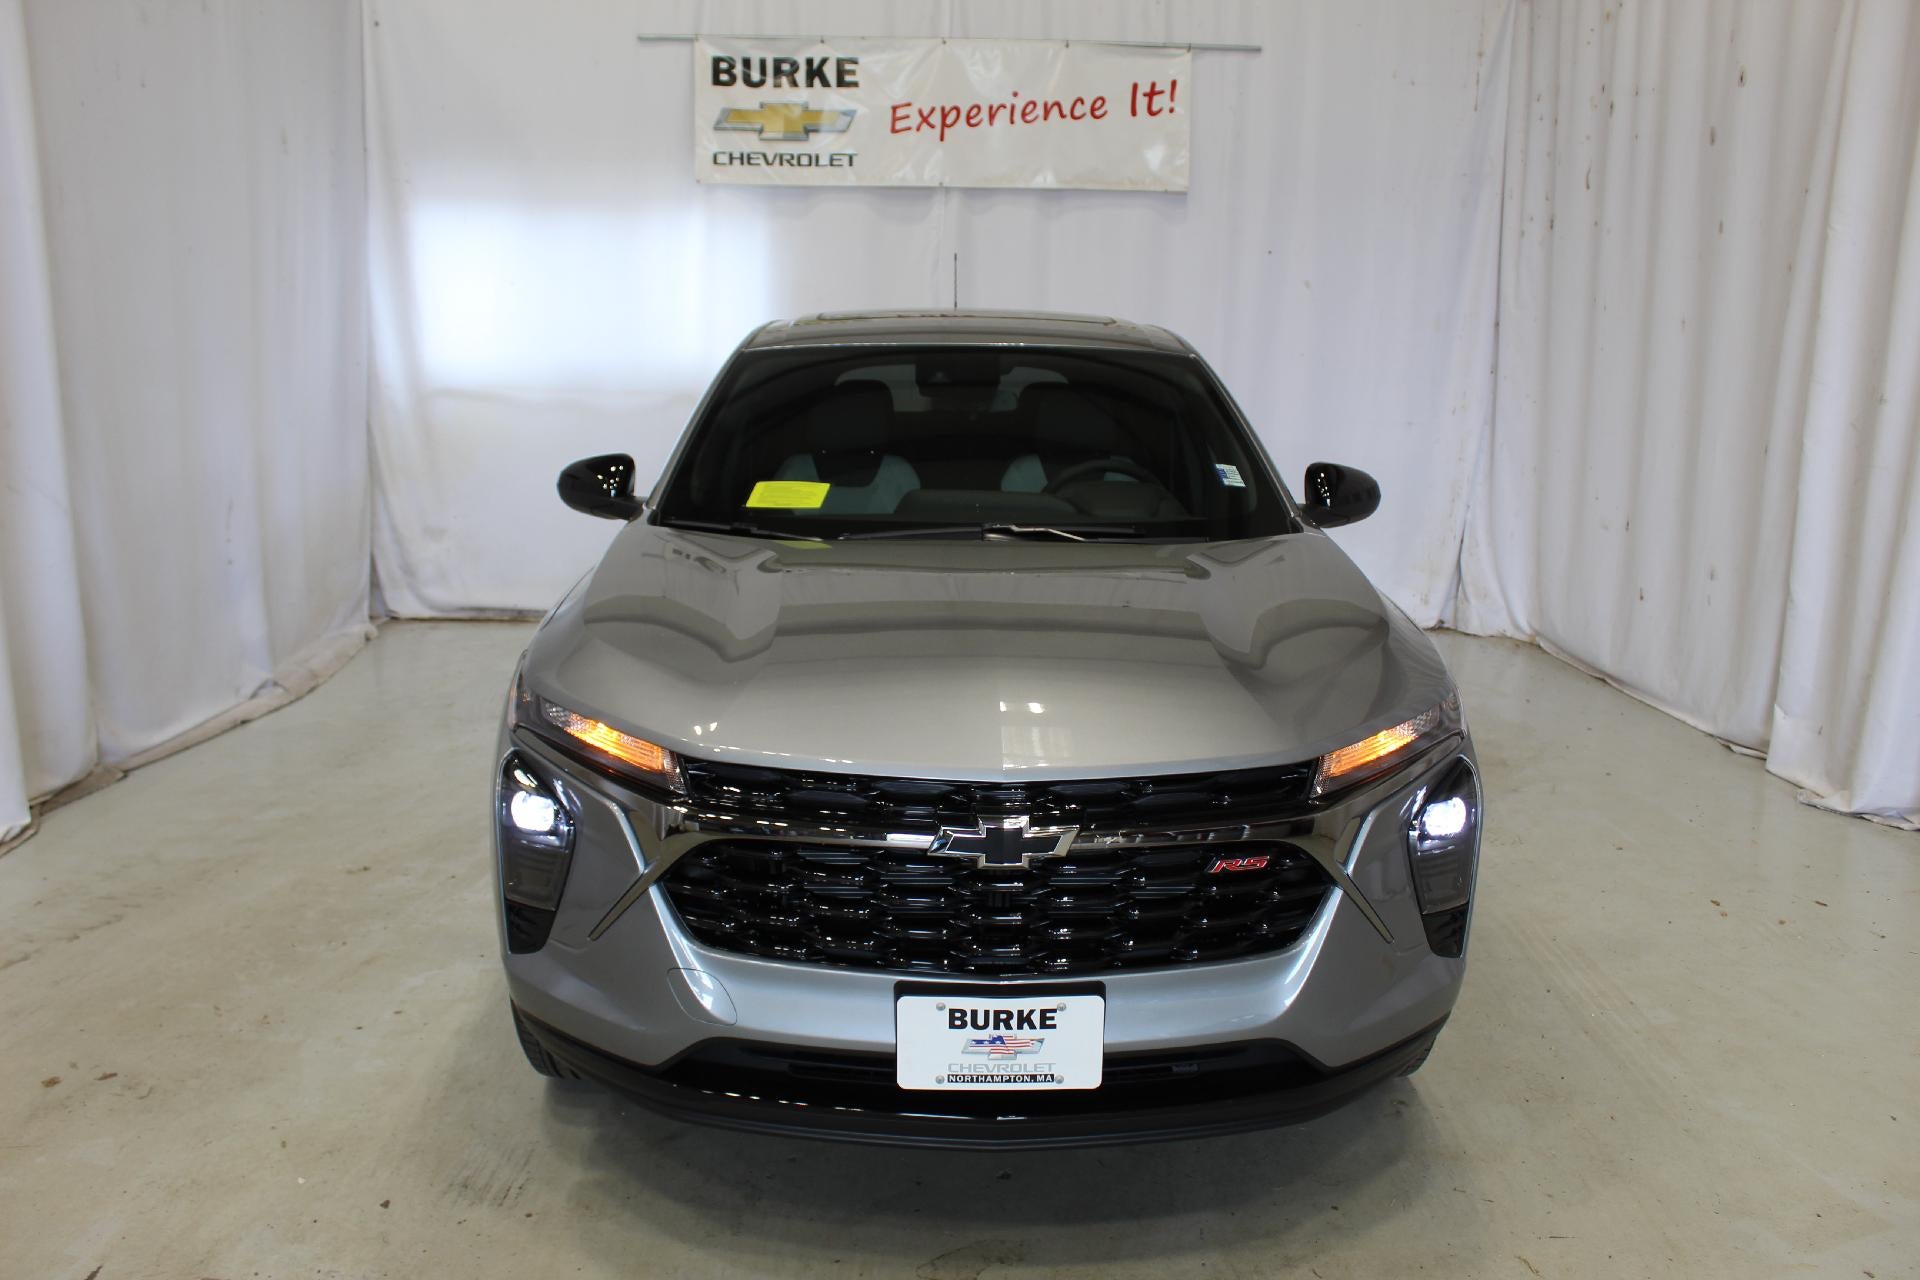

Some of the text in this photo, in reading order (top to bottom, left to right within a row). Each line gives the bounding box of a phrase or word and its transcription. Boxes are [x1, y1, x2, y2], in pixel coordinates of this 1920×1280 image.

[711, 55, 860, 89] BURKE
[890, 79, 1178, 142] Experience It!
[713, 151, 858, 168] CHEVROLET
[1207, 855, 1270, 873] RS
[948, 1008, 1058, 1030] BURKE
[947, 1063, 1056, 1074] CHEVROLET
[1036, 1074, 1053, 1083] MA
